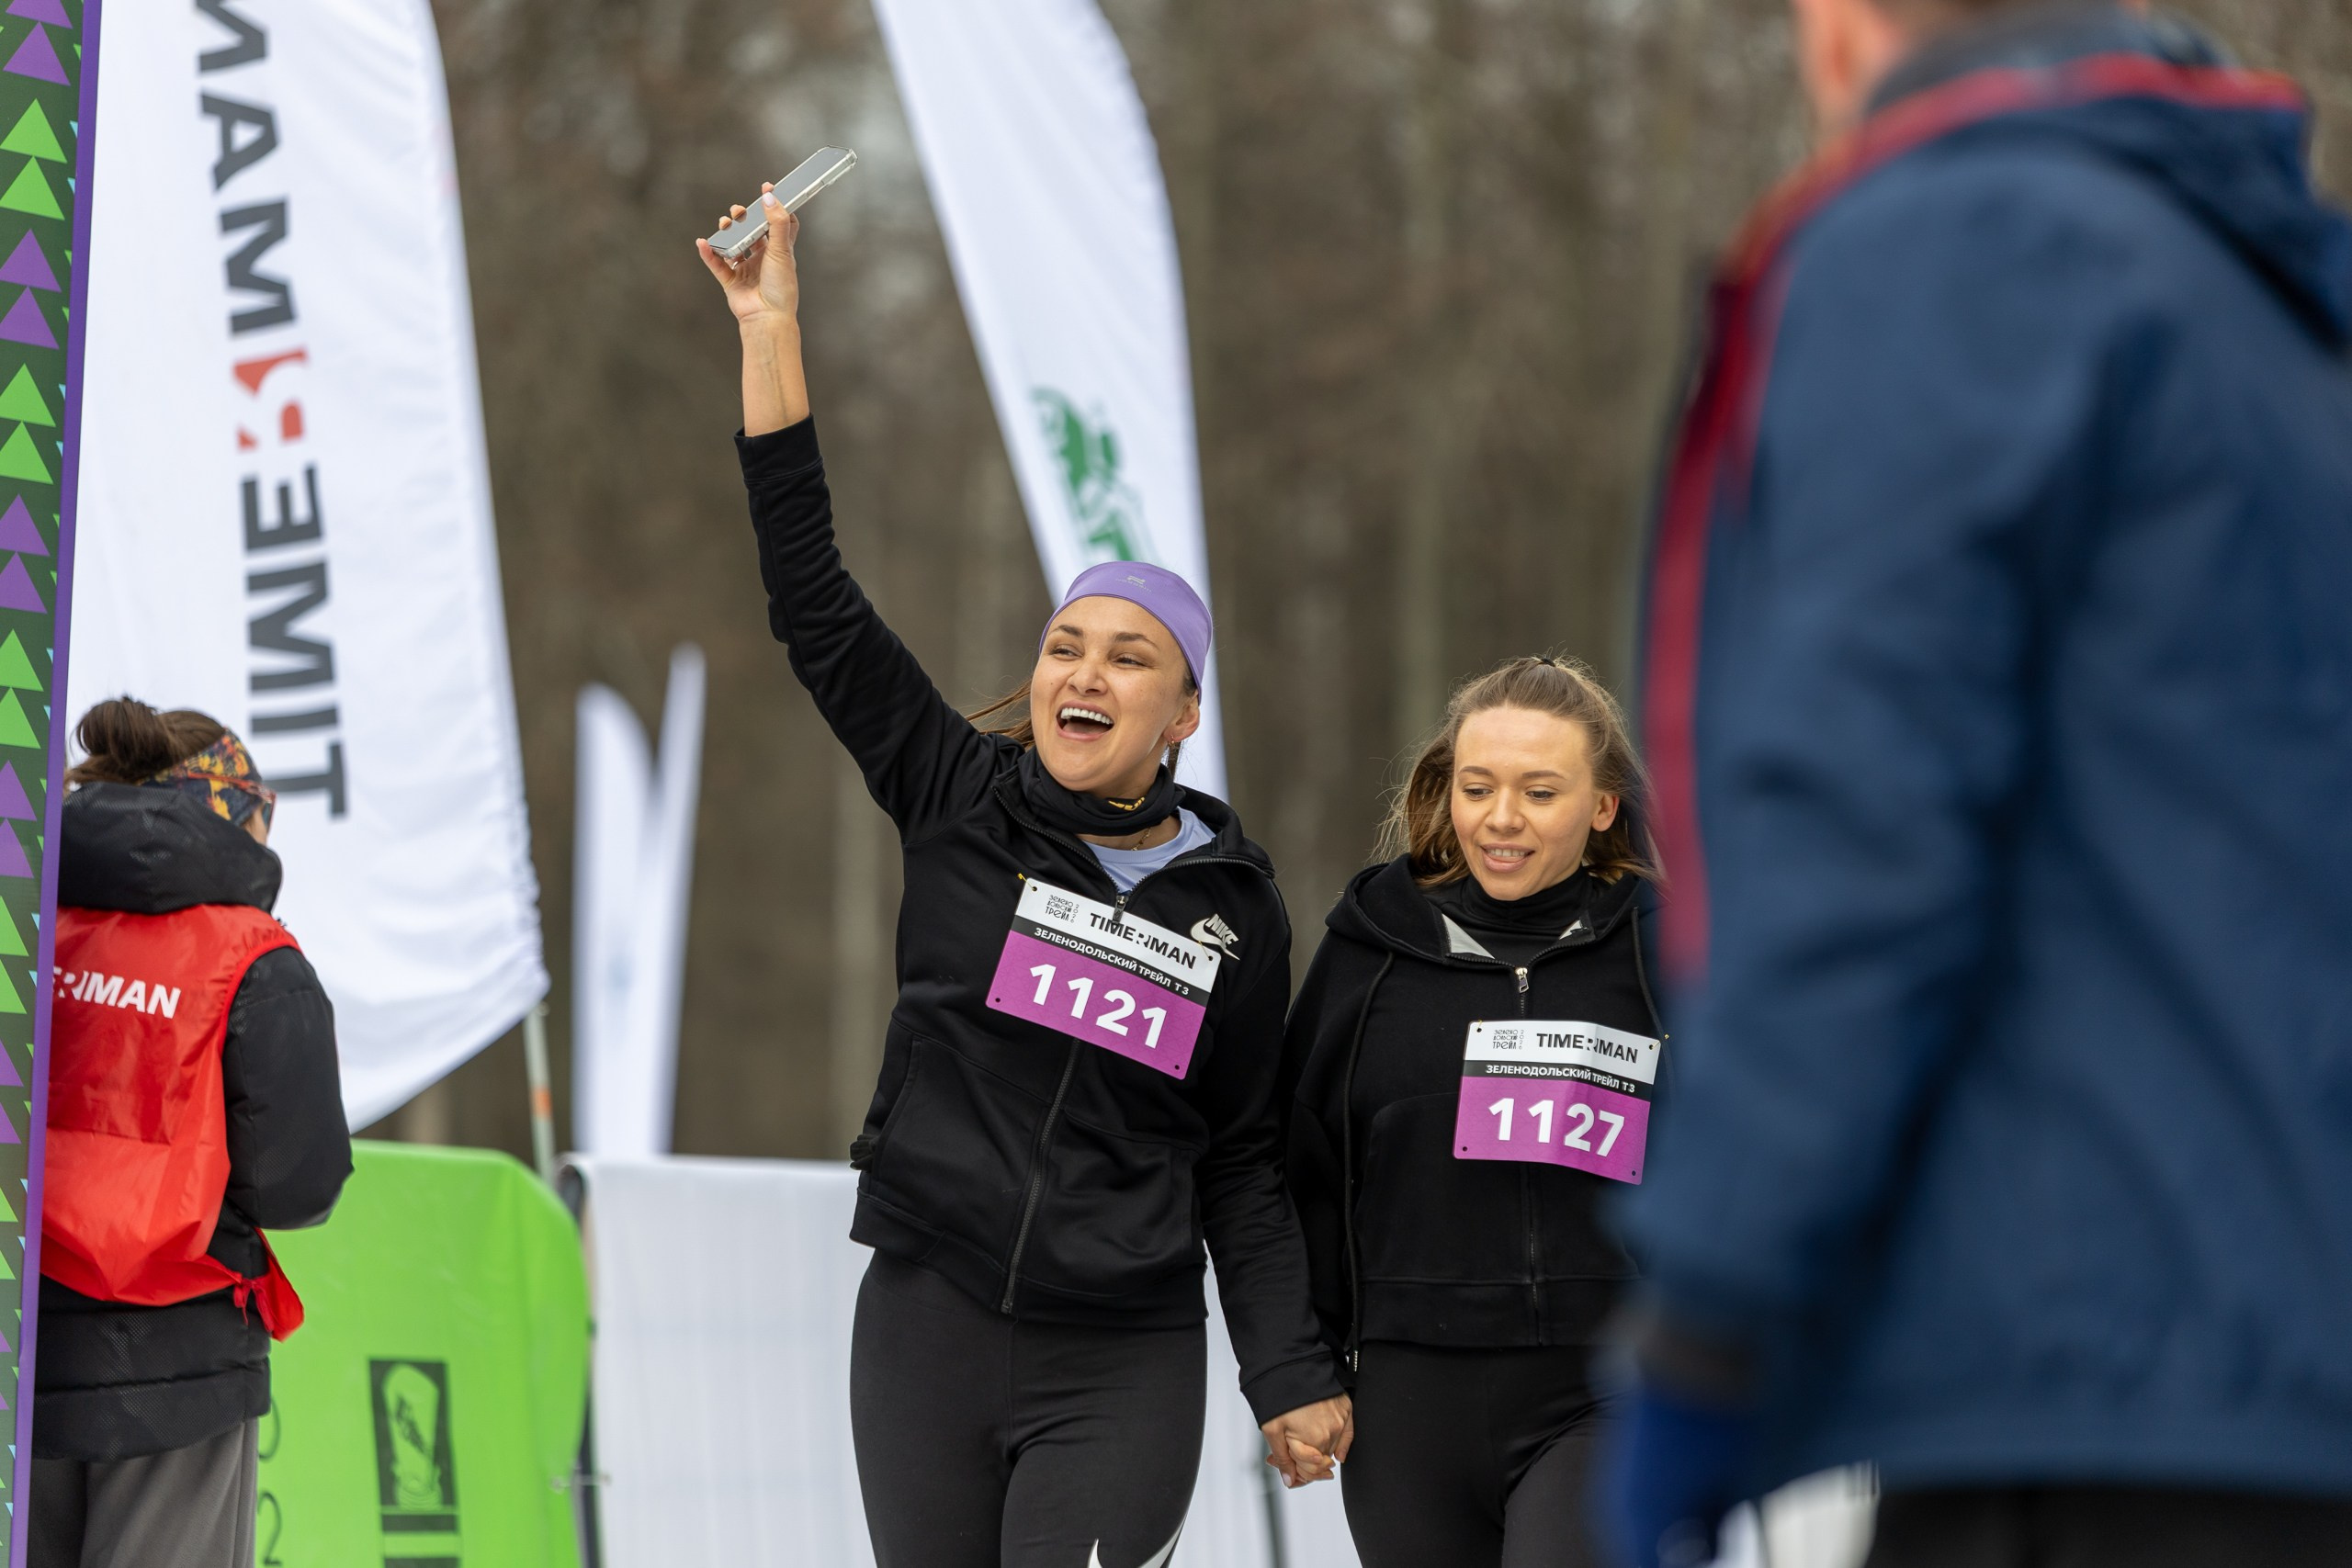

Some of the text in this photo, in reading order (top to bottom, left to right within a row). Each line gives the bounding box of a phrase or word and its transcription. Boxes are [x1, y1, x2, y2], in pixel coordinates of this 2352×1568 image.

[1034, 927, 1137, 971] ЗЕЛЕНОДОЛЬСКИЙ
[1138, 965, 1171, 987] ТРЕЙЛ
[1090, 913, 1196, 969] TIMERMAN
[1204, 913, 1239, 947] NIKE
[1029, 964, 1168, 1049] 1121
[1536, 1032, 1638, 1064] TIMERMAN
[1486, 1064, 1591, 1080] ЗЕЛЕНОДОЛЬСКИЙ
[1592, 1072, 1620, 1089] ТРЕЙЛ
[1488, 1098, 1625, 1157] 1127
